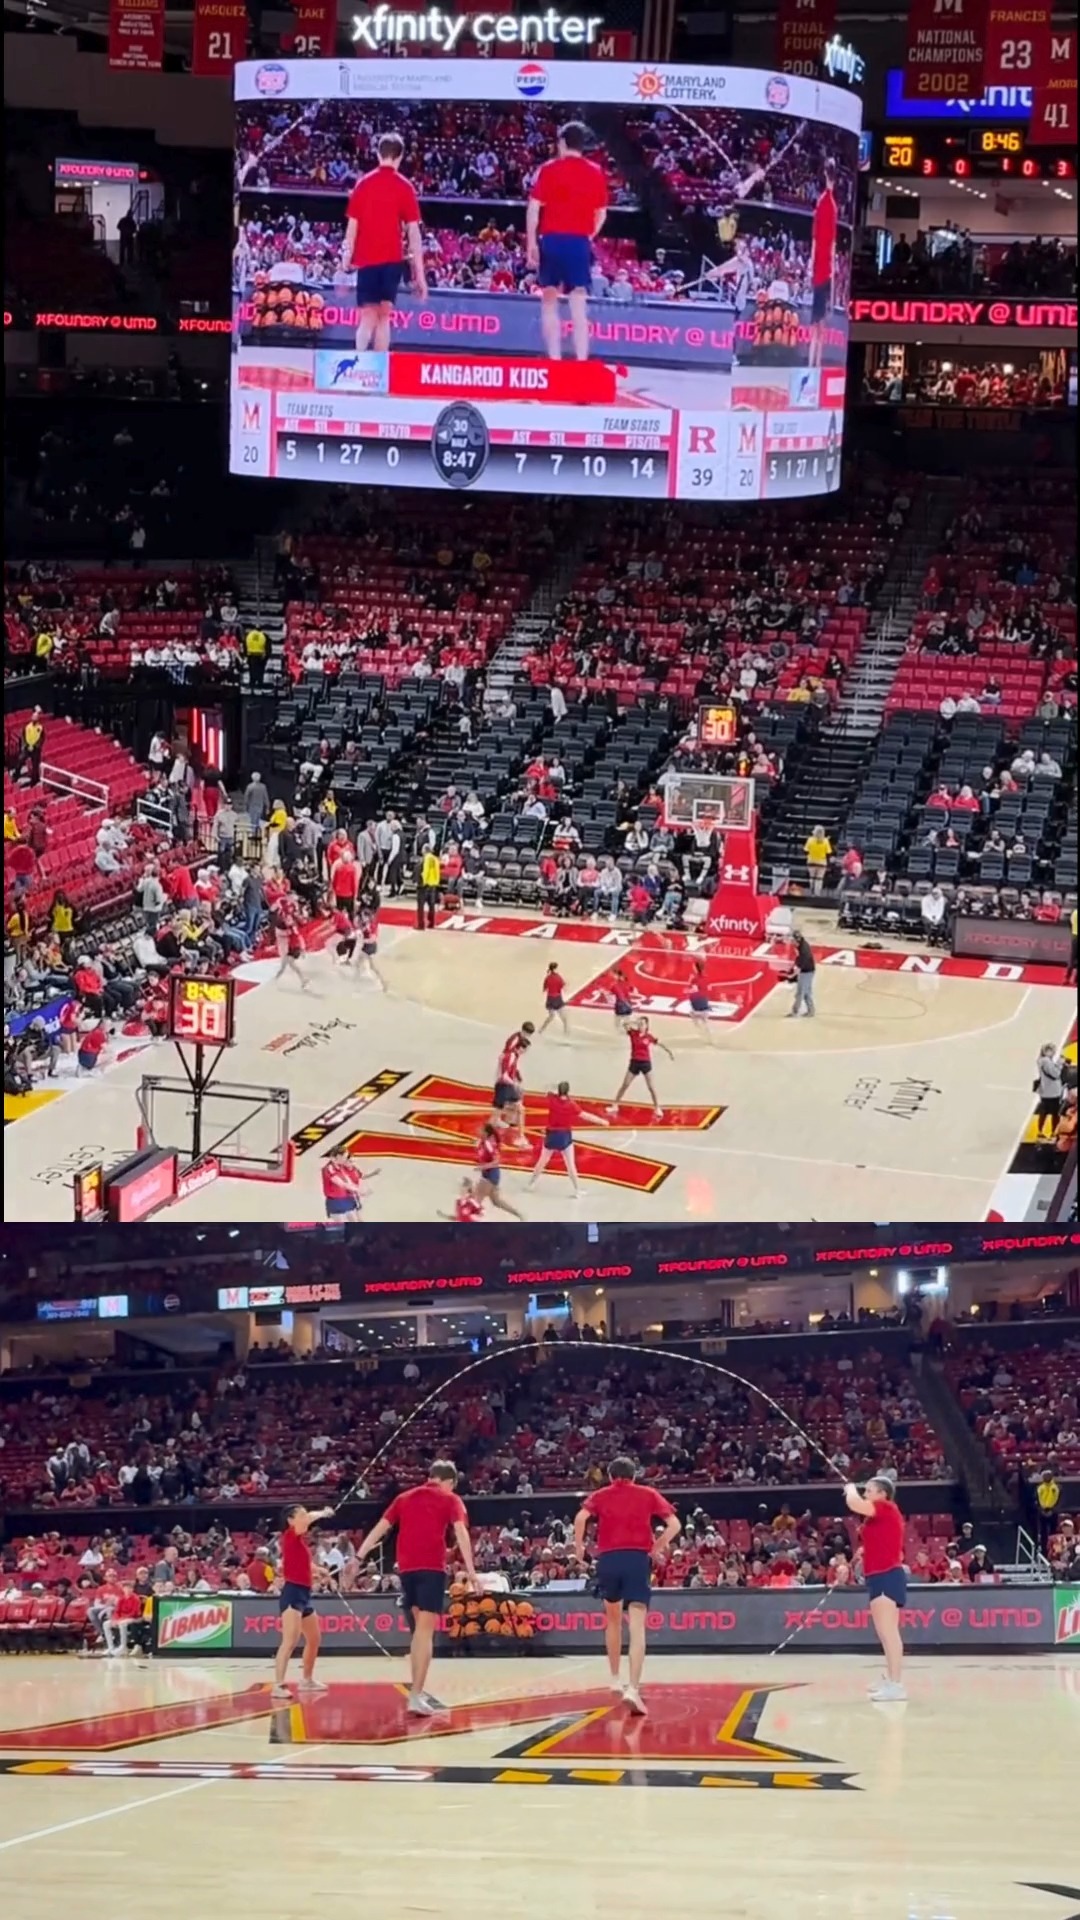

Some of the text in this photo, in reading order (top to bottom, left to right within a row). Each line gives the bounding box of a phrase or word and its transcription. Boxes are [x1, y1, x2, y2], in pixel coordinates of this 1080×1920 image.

[990, 10, 1046, 22] FRANCIS
[352, 4, 602, 50] xfinity center
[783, 22, 826, 34] FINAL
[208, 32, 232, 59] 21
[784, 37, 823, 50] FOUR
[917, 29, 976, 45] NATIONAL
[597, 37, 615, 57] M
[908, 48, 983, 63] CHAMPIONS
[1000, 40, 1032, 69] 23
[1051, 38, 1071, 60] M
[664, 75, 726, 89] MARYLAND
[918, 73, 969, 92] 2002
[1044, 103, 1069, 128] 41
[982, 132, 1020, 151] 8:46
[889, 147, 913, 166] 20
[923, 159, 934, 175] 3
[955, 160, 966, 174] 0
[1023, 161, 1034, 176] 0
[1057, 161, 1069, 176] 3
[36, 314, 109, 329] XFOUNDRY
[123, 316, 157, 329] UMD
[418, 310, 437, 329] @
[988, 303, 1011, 324] @
[420, 364, 549, 389] KANGAROO KIDS
[242, 401, 261, 430] M
[286, 402, 334, 418] TEAM STATS
[452, 420, 469, 433] 30
[603, 418, 661, 433] TEAM STATS
[512, 430, 531, 443] AST
[549, 432, 566, 447] STL
[688, 425, 717, 453] R
[737, 422, 758, 454] M
[243, 446, 259, 463] 20
[286, 440, 400, 467] 5 1 27 0
[442, 450, 477, 468] 8:47
[515, 453, 655, 479] 7 7 10 14
[770, 460, 778, 480] 5
[691, 468, 713, 487] 39
[740, 469, 753, 487] 20
[702, 720, 731, 740] 30
[709, 914, 759, 936] xfinity
[174, 1000, 221, 1037] 30
[158, 1602, 230, 1646] LIBMAN
[375, 1613, 394, 1633] @
[669, 1610, 737, 1631] UMD
[940, 1607, 963, 1628] @
[969, 1607, 1042, 1629] UMD
